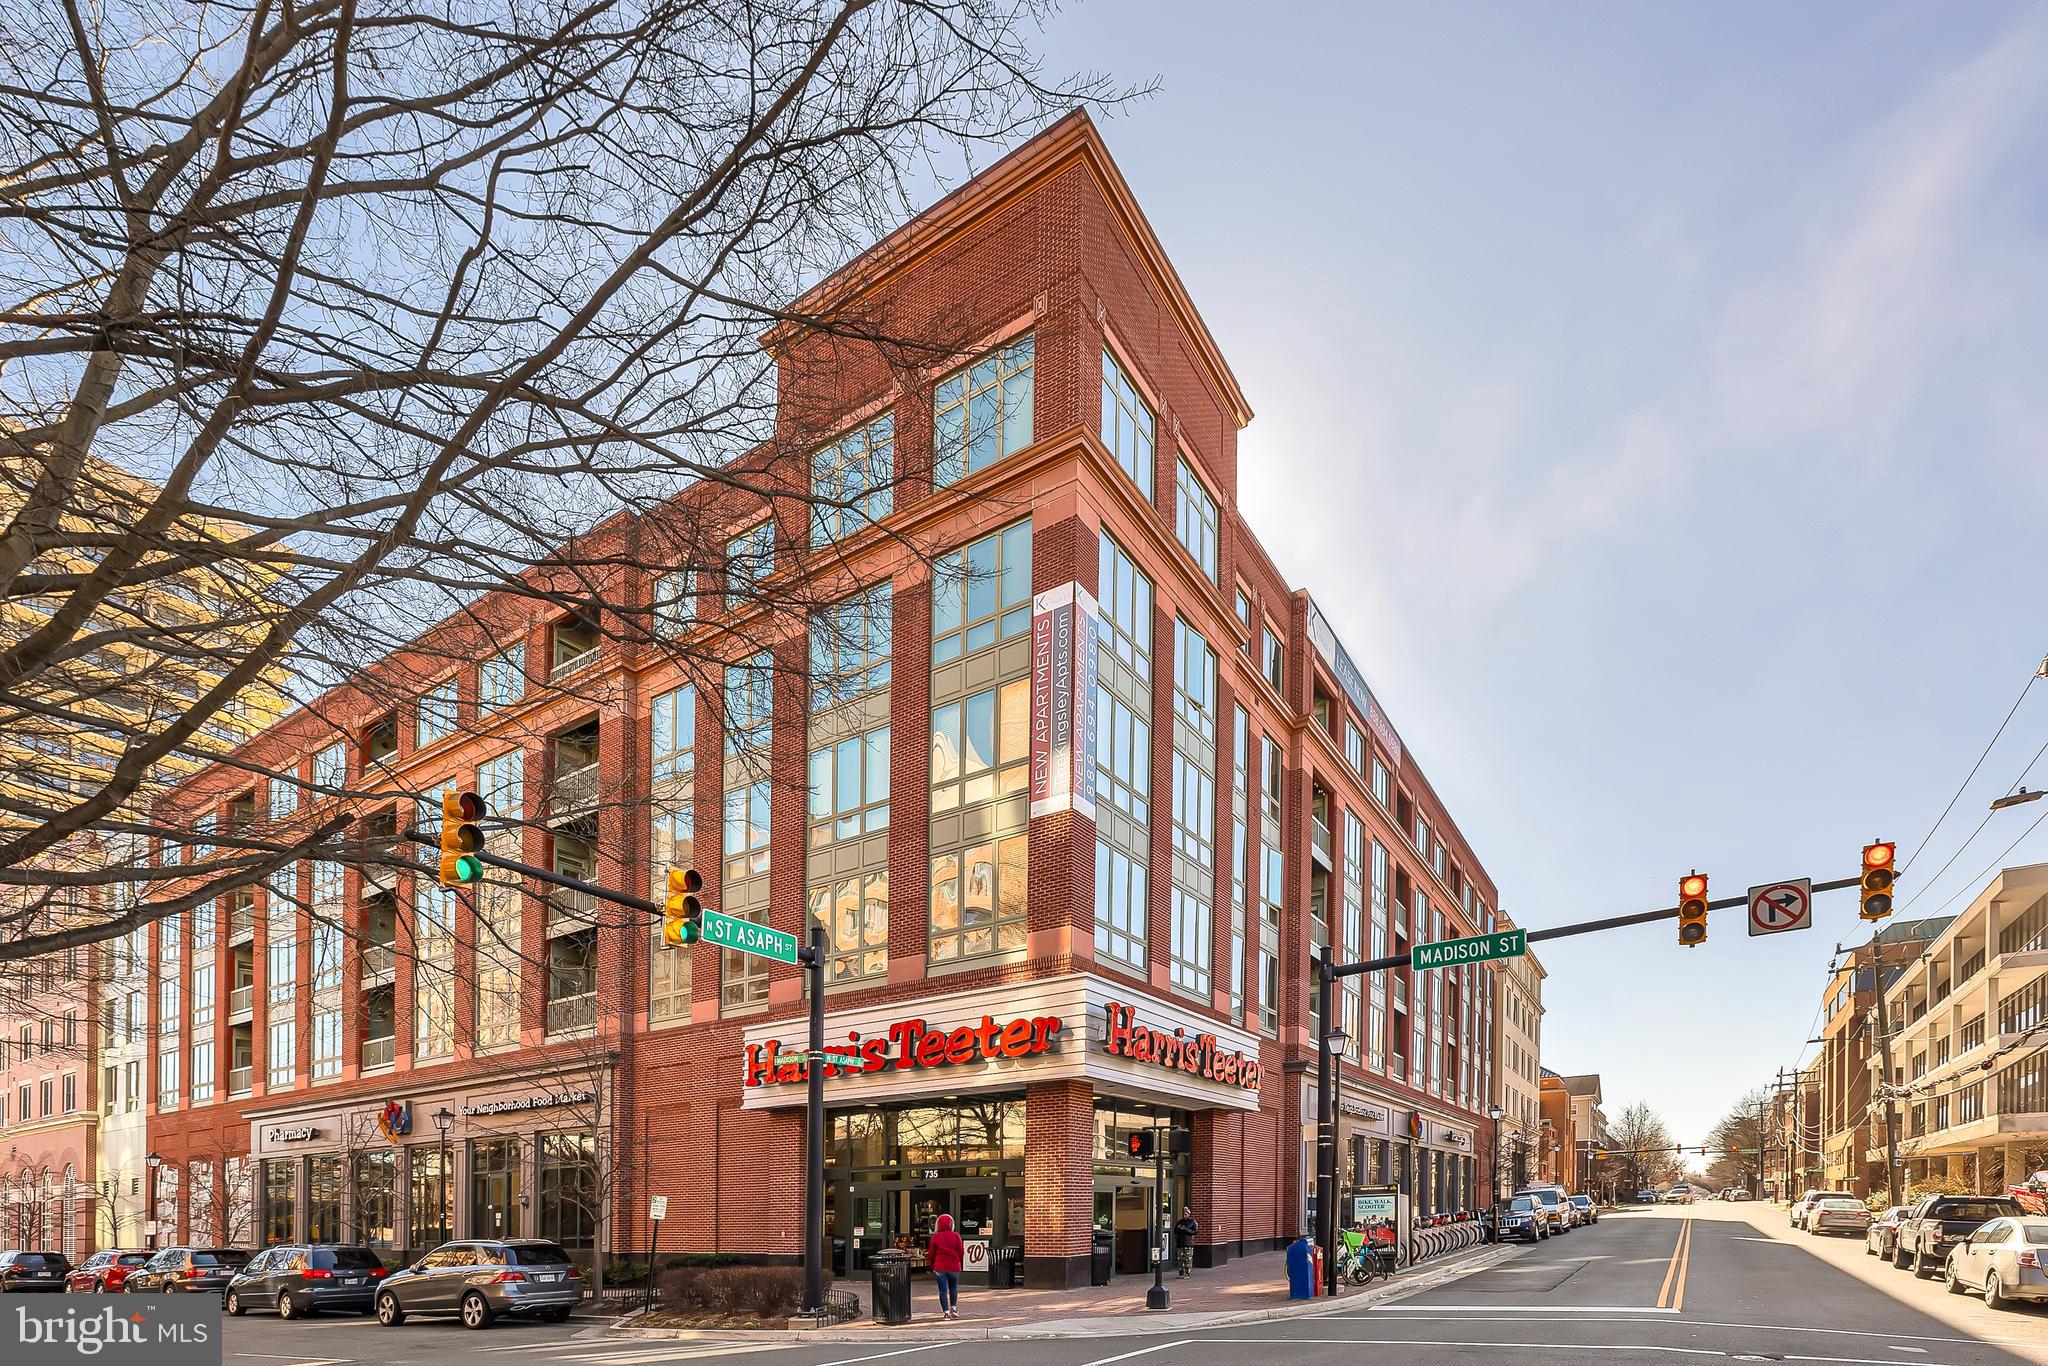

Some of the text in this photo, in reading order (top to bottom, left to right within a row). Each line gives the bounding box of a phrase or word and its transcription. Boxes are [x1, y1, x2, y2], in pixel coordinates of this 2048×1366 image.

[1034, 619, 1050, 795] NEW APARTMENTS
[1075, 614, 1086, 790] NEW APARTMENTS
[1086, 626, 1097, 797] 888.694.0980
[706, 919, 793, 955] N ST ASAPH ST
[1420, 935, 1519, 965] MADISON ST
[459, 1105, 475, 1116] Your
[476, 1097, 530, 1116] Neighborhood
[532, 1094, 552, 1107] Food
[268, 1127, 313, 1142] Pharmacy
[924, 1169, 939, 1179] 735
